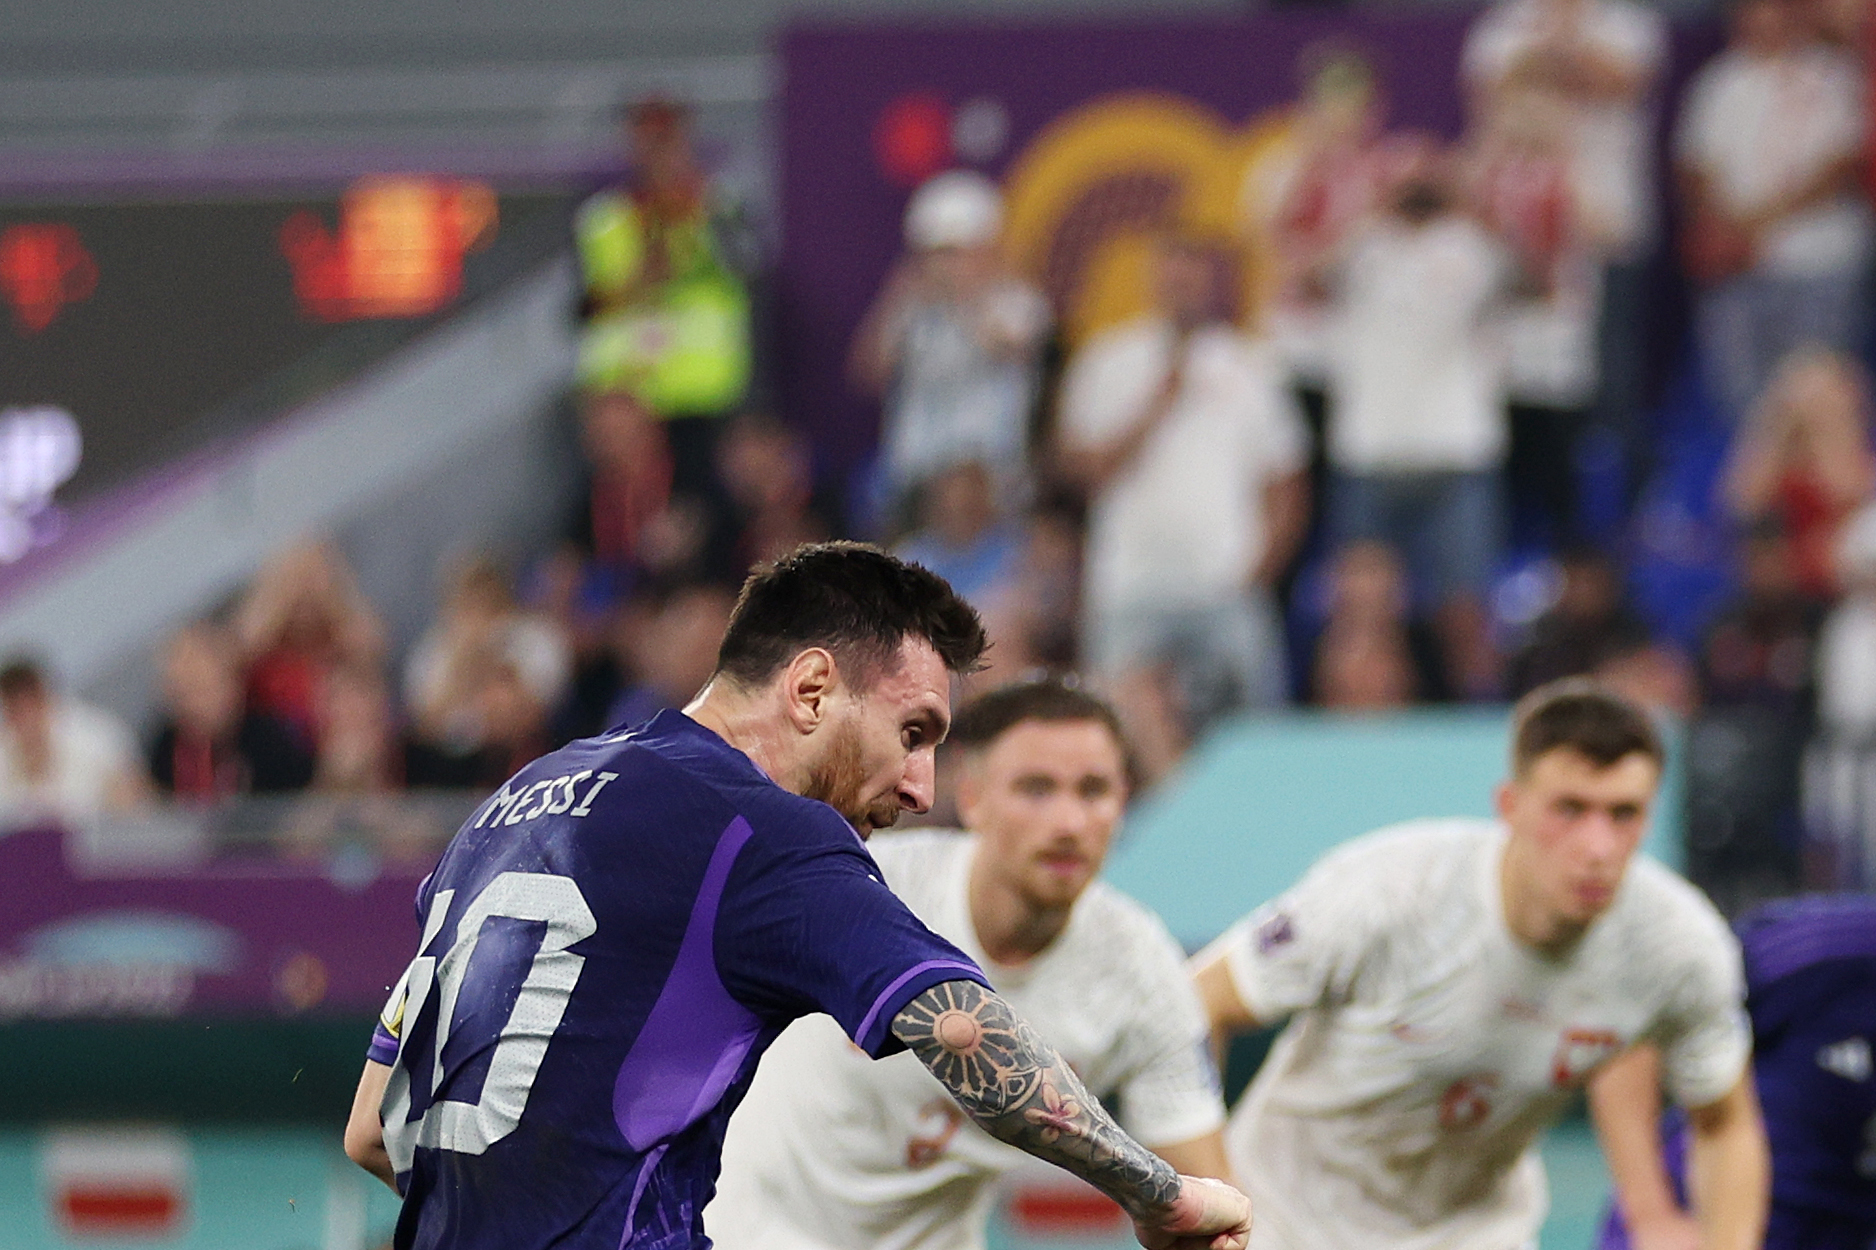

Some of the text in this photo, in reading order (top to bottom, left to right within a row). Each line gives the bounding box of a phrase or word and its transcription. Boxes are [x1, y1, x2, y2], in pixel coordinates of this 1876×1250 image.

[474, 769, 620, 829] MESSI
[379, 871, 597, 1174] 10
[1437, 1071, 1500, 1133] 6
